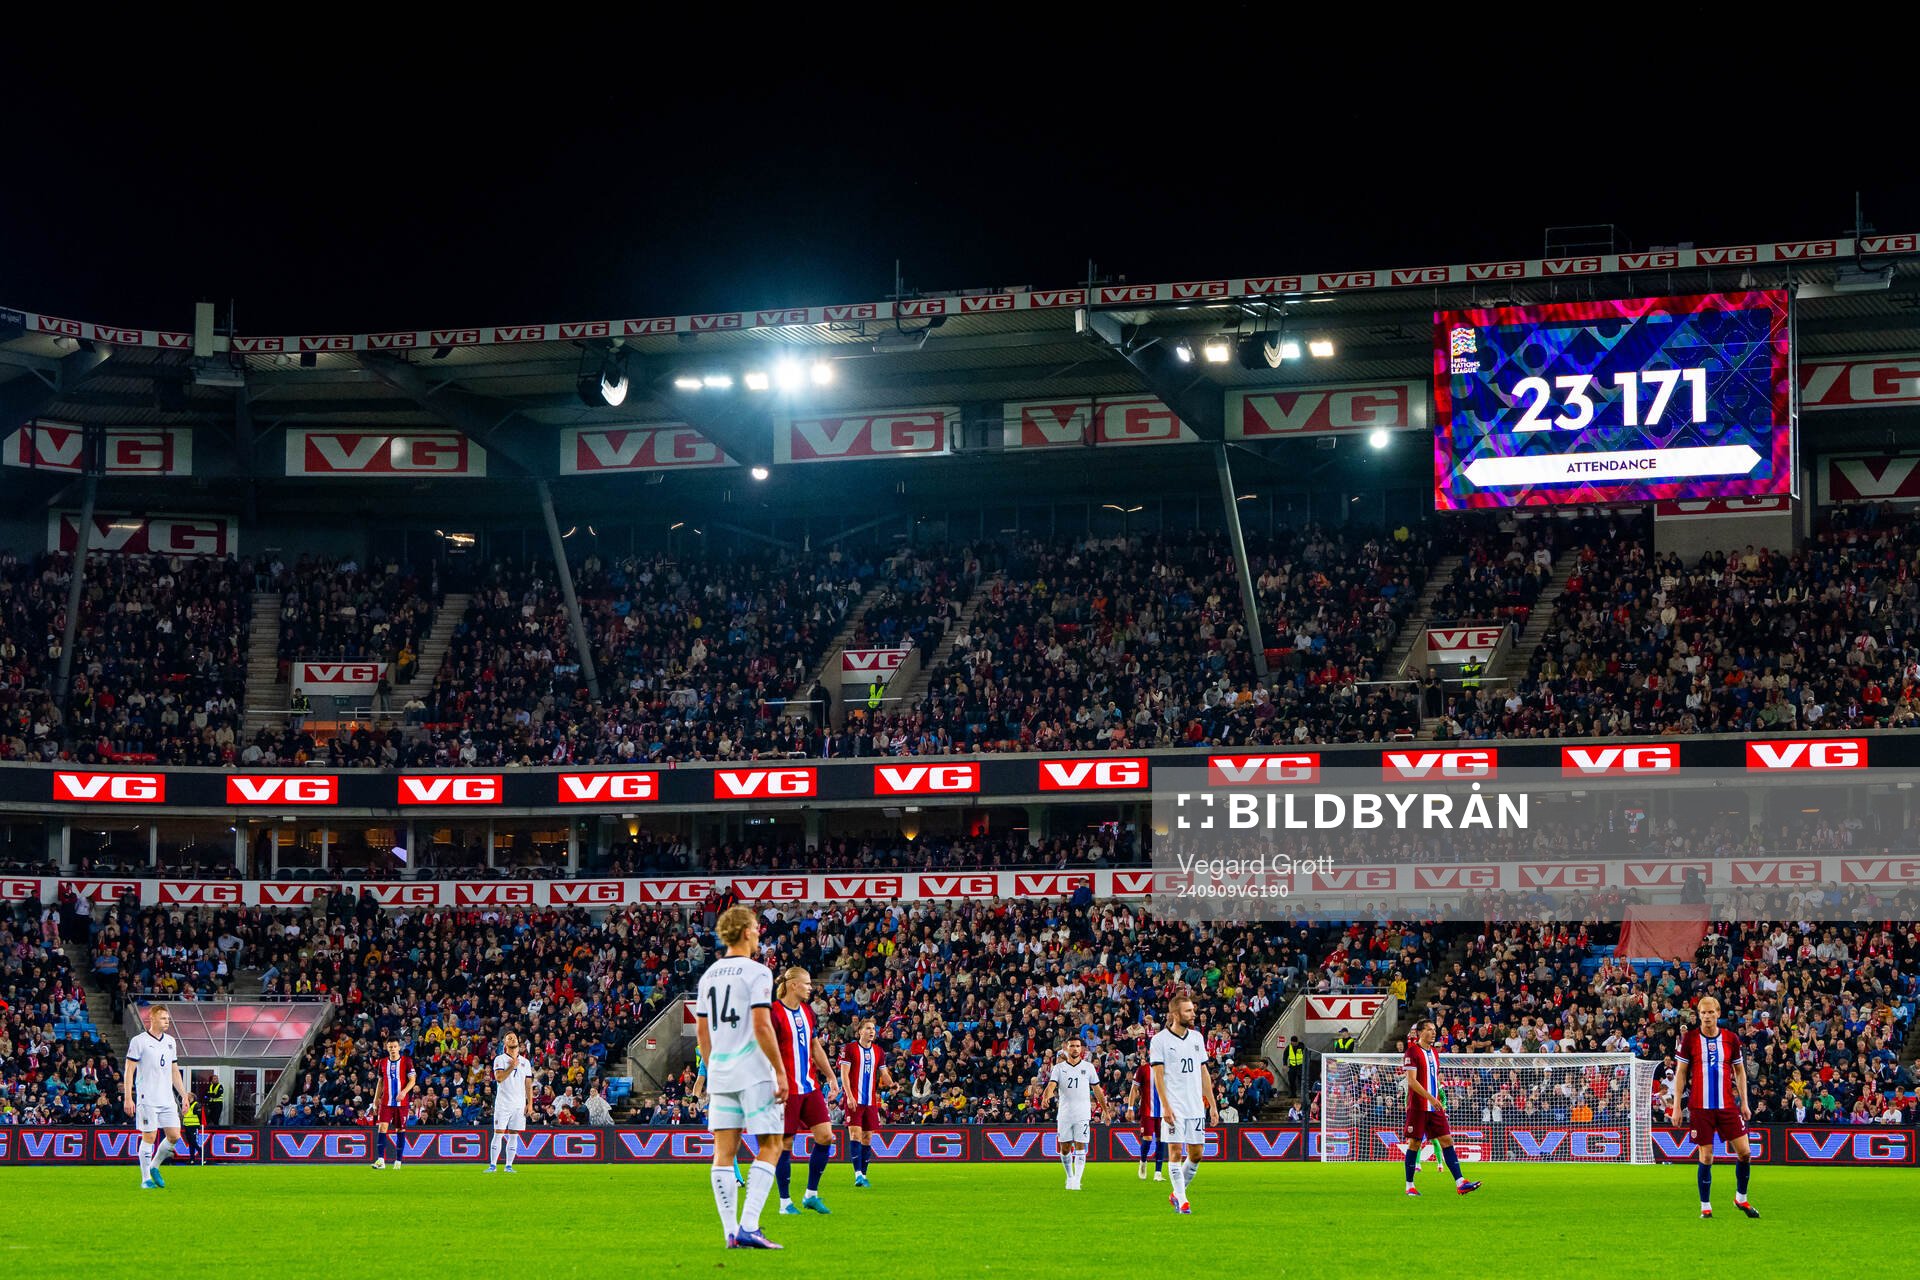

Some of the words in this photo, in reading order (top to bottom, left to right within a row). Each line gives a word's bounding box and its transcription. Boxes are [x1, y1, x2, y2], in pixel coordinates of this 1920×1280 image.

[1776, 242, 1835, 257] VG
[1861, 237, 1917, 252] VG
[1620, 254, 1677, 269] VG
[1697, 248, 1756, 263] VG
[1468, 264, 1523, 279] VG
[1544, 259, 1600, 274] VG
[1318, 274, 1374, 289] VG
[1393, 269, 1447, 284] VG
[1103, 287, 1155, 301] VG
[1174, 282, 1227, 297] VG
[1246, 279, 1300, 293] VG
[898, 301, 944, 315] VG
[962, 296, 1014, 311] VG
[1032, 292, 1083, 306] VG
[758, 311, 807, 325] VG
[825, 305, 875, 320] VG
[40, 317, 81, 335] VG
[560, 323, 608, 337] VG
[625, 319, 674, 333] VG
[691, 315, 740, 329] VG
[96, 327, 140, 344] VG
[160, 334, 192, 347] V
[370, 335, 415, 347] VG
[433, 330, 479, 344] VG
[496, 327, 543, 341] VG
[233, 339, 280, 351] VG
[303, 338, 352, 351] VG
[1511, 374, 1594, 433] 23
[1614, 367, 1707, 427] 171
[1248, 389, 1397, 431] VG
[1026, 402, 1172, 443] VG
[797, 415, 937, 456] VG
[24, 427, 163, 469] VG
[310, 437, 459, 470] VG
[582, 429, 723, 467] VG
[1566, 458, 1657, 474] ATTENDANCE
[1835, 458, 1920, 497] V
[65, 516, 218, 553] VG
[1431, 630, 1498, 649] VG
[846, 652, 907, 669] VG
[307, 666, 373, 681] VG
[1567, 747, 1671, 773] VG
[1751, 742, 1859, 768] VG
[1044, 761, 1140, 786] VG
[1213, 756, 1312, 782] VG
[1388, 752, 1489, 777] VG
[58, 775, 157, 799] VG
[563, 775, 652, 799] VG
[718, 771, 810, 795] VG
[879, 766, 973, 791] VG
[232, 778, 329, 801] VG
[403, 778, 495, 801] VG
[1316, 868, 1392, 889] VG
[1418, 867, 1495, 888] VG
[1521, 865, 1601, 887] VG
[1734, 863, 1816, 882] VG
[1845, 861, 1920, 881] VG
[0, 881, 36, 898] G
[643, 882, 711, 900] VG
[734, 880, 803, 898] VG
[829, 878, 898, 897] VG
[924, 876, 993, 895] VG
[1116, 872, 1189, 893] VG
[164, 884, 236, 902] VG
[364, 886, 434, 902] VG
[459, 885, 528, 902] VG
[554, 883, 618, 901] VG
[707, 984, 740, 1031] 14
[1307, 997, 1386, 1018] VG
[160, 1054, 165, 1067] 6
[1181, 1058, 1193, 1073] 20
[1067, 1077, 1079, 1089] 21
[23, 1133, 83, 1157] VG
[276, 1133, 367, 1159] VG
[387, 1133, 480, 1158] VG
[620, 1132, 714, 1158] VG
[871, 1132, 961, 1158] VG
[1244, 1132, 1350, 1157] VG
[1512, 1132, 1621, 1157] VG
[1791, 1132, 1905, 1159] VG
